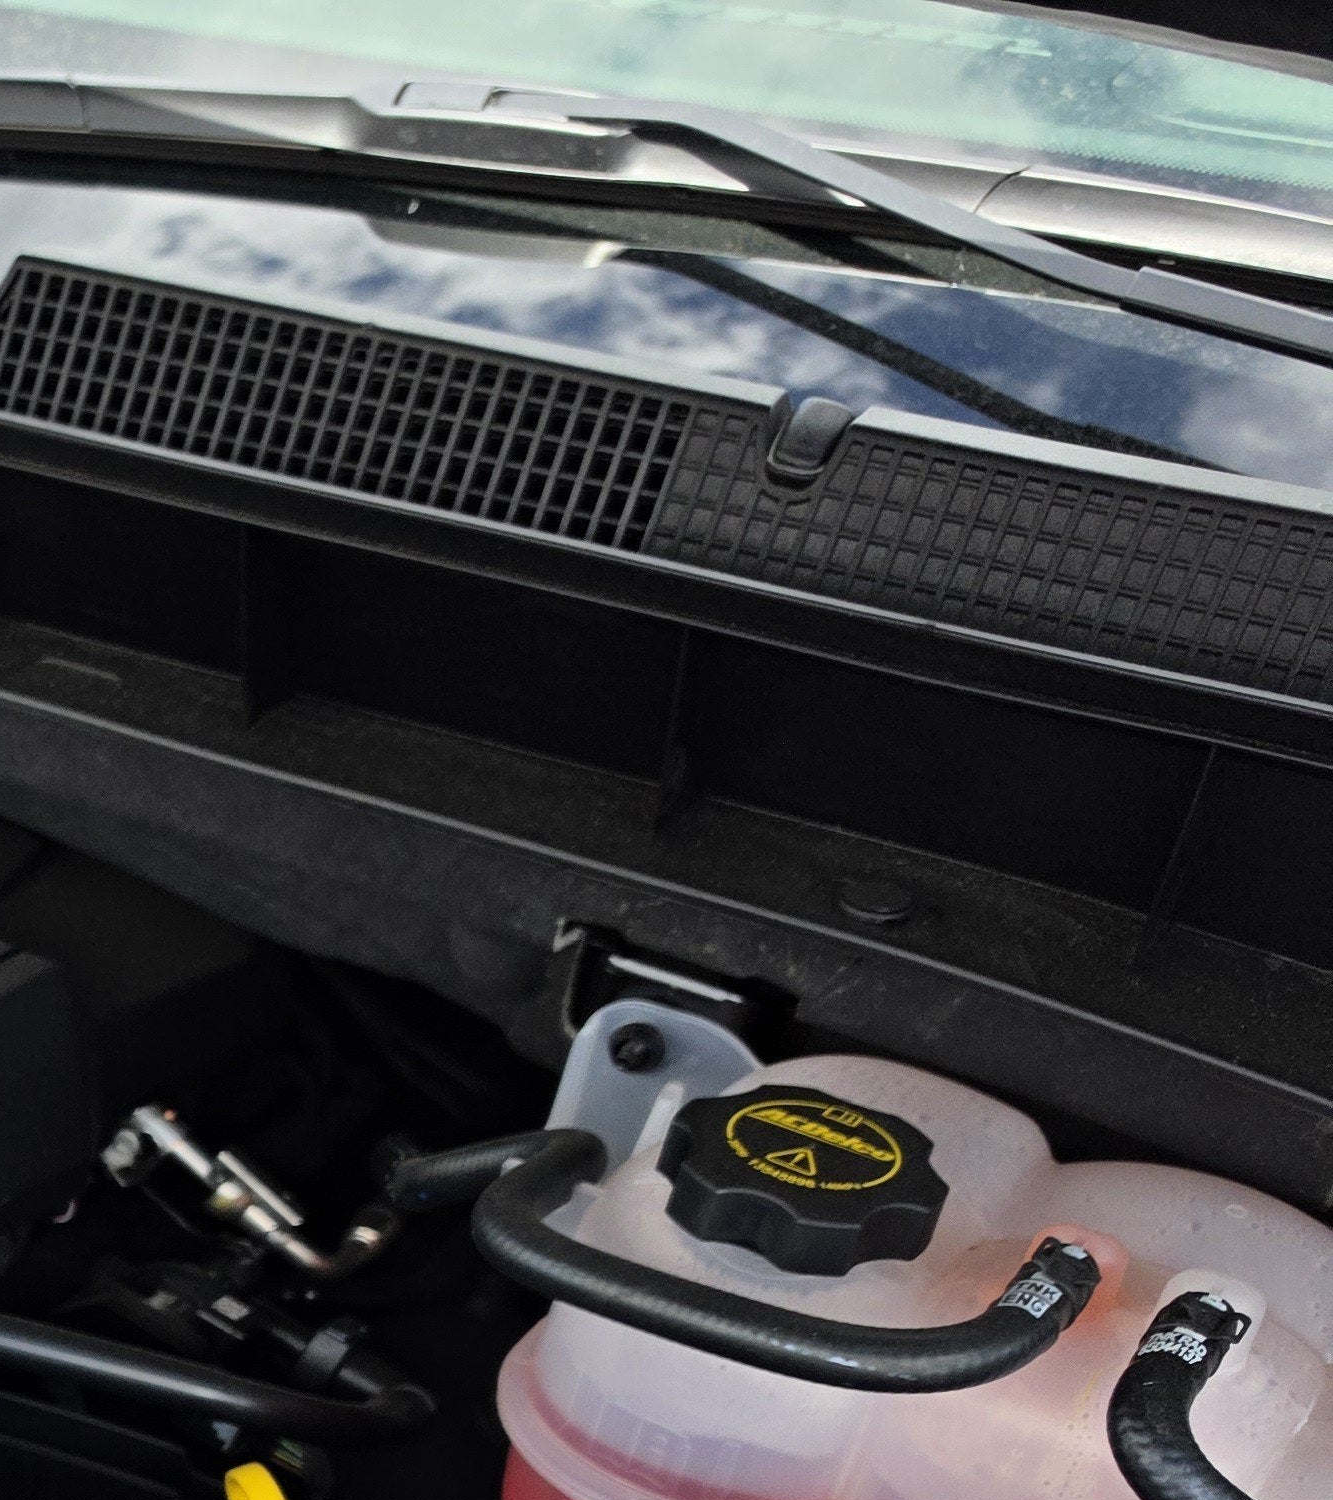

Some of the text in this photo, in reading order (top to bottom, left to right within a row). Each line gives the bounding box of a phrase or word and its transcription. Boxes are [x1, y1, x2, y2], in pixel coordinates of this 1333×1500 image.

[746, 1108, 897, 1162] ACDelco
[1014, 1281, 1058, 1302] TNK
[1178, 1334, 1208, 1358] RAD
